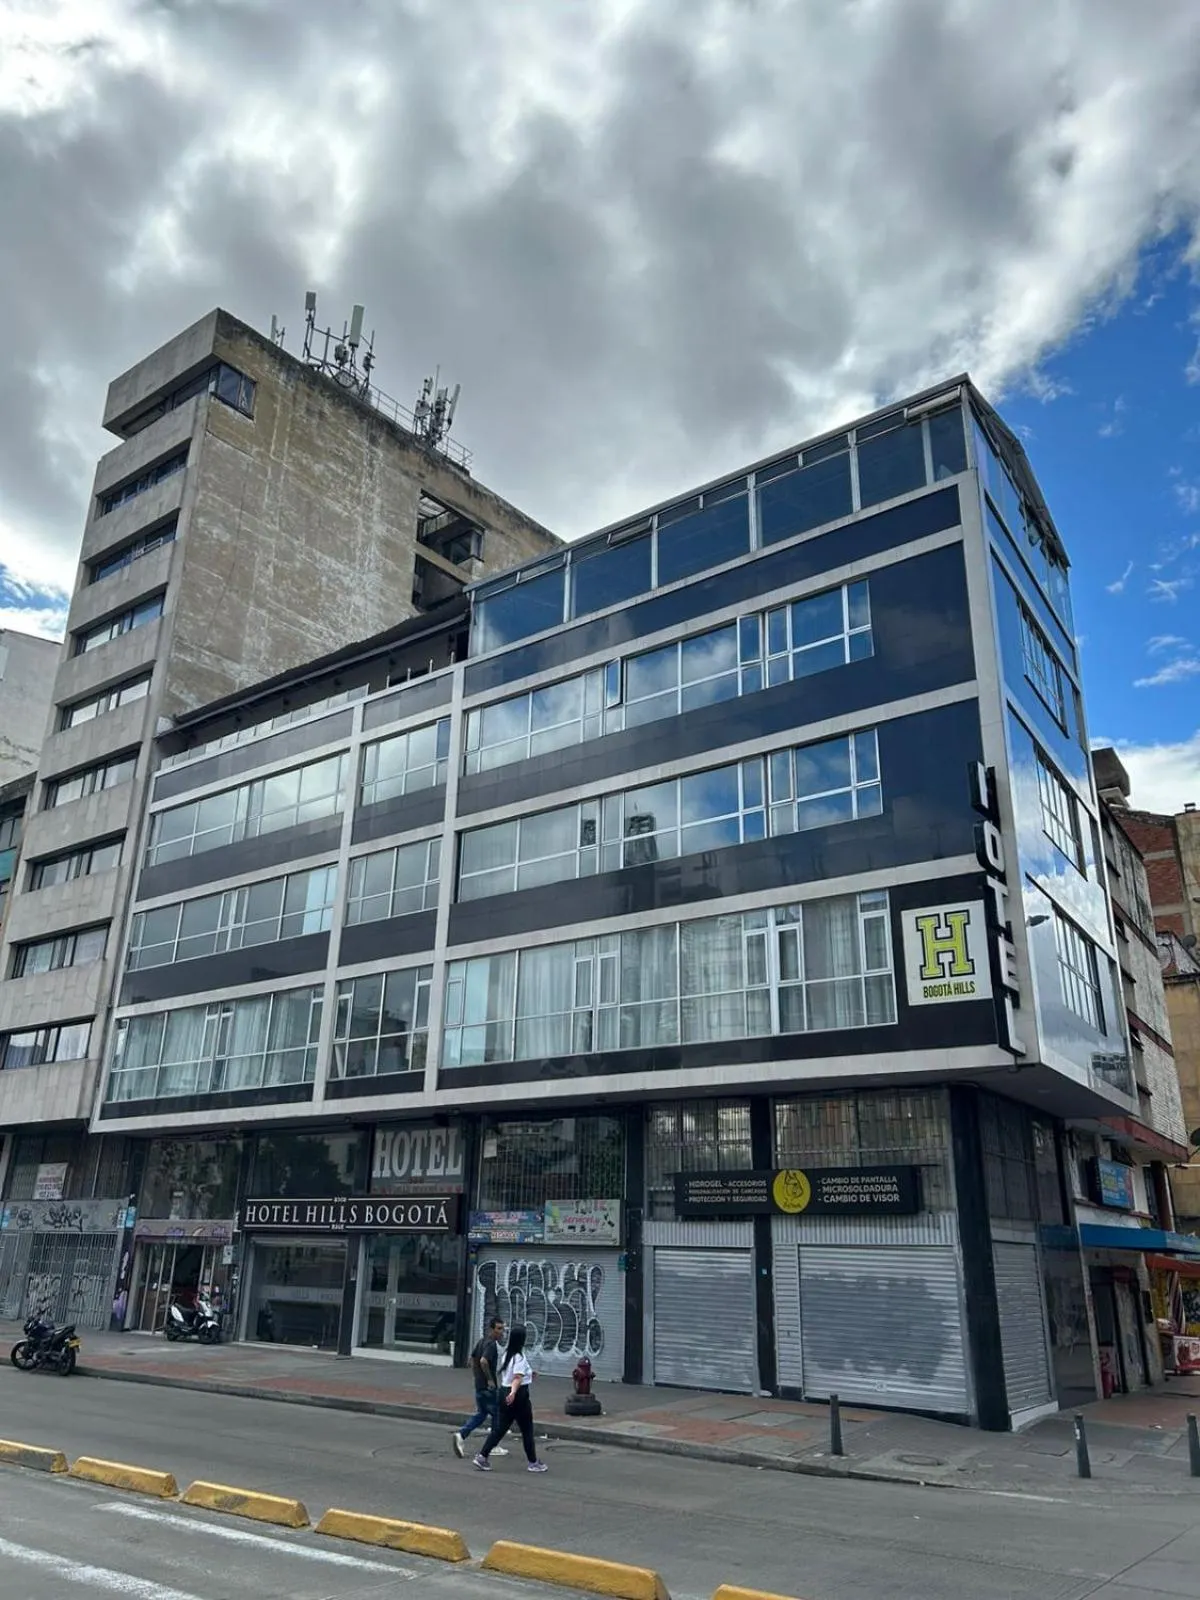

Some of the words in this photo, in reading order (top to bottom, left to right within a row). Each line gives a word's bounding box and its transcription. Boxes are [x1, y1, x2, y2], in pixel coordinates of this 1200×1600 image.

[915, 909, 975, 980] H
[923, 981, 952, 998] BOGOTÁ
[953, 981, 975, 996] HILLS
[372, 1127, 462, 1178] HOTEL
[861, 1175, 897, 1183] PANTALLA
[822, 1184, 898, 1193] MICROSOLDADURA
[823, 1194, 857, 1203] CAMBIO
[859, 1194, 871, 1202] DE
[245, 1205, 299, 1222] HOTEL
[306, 1204, 358, 1223] HILLS
[365, 1201, 448, 1224] BOGOTÁ
